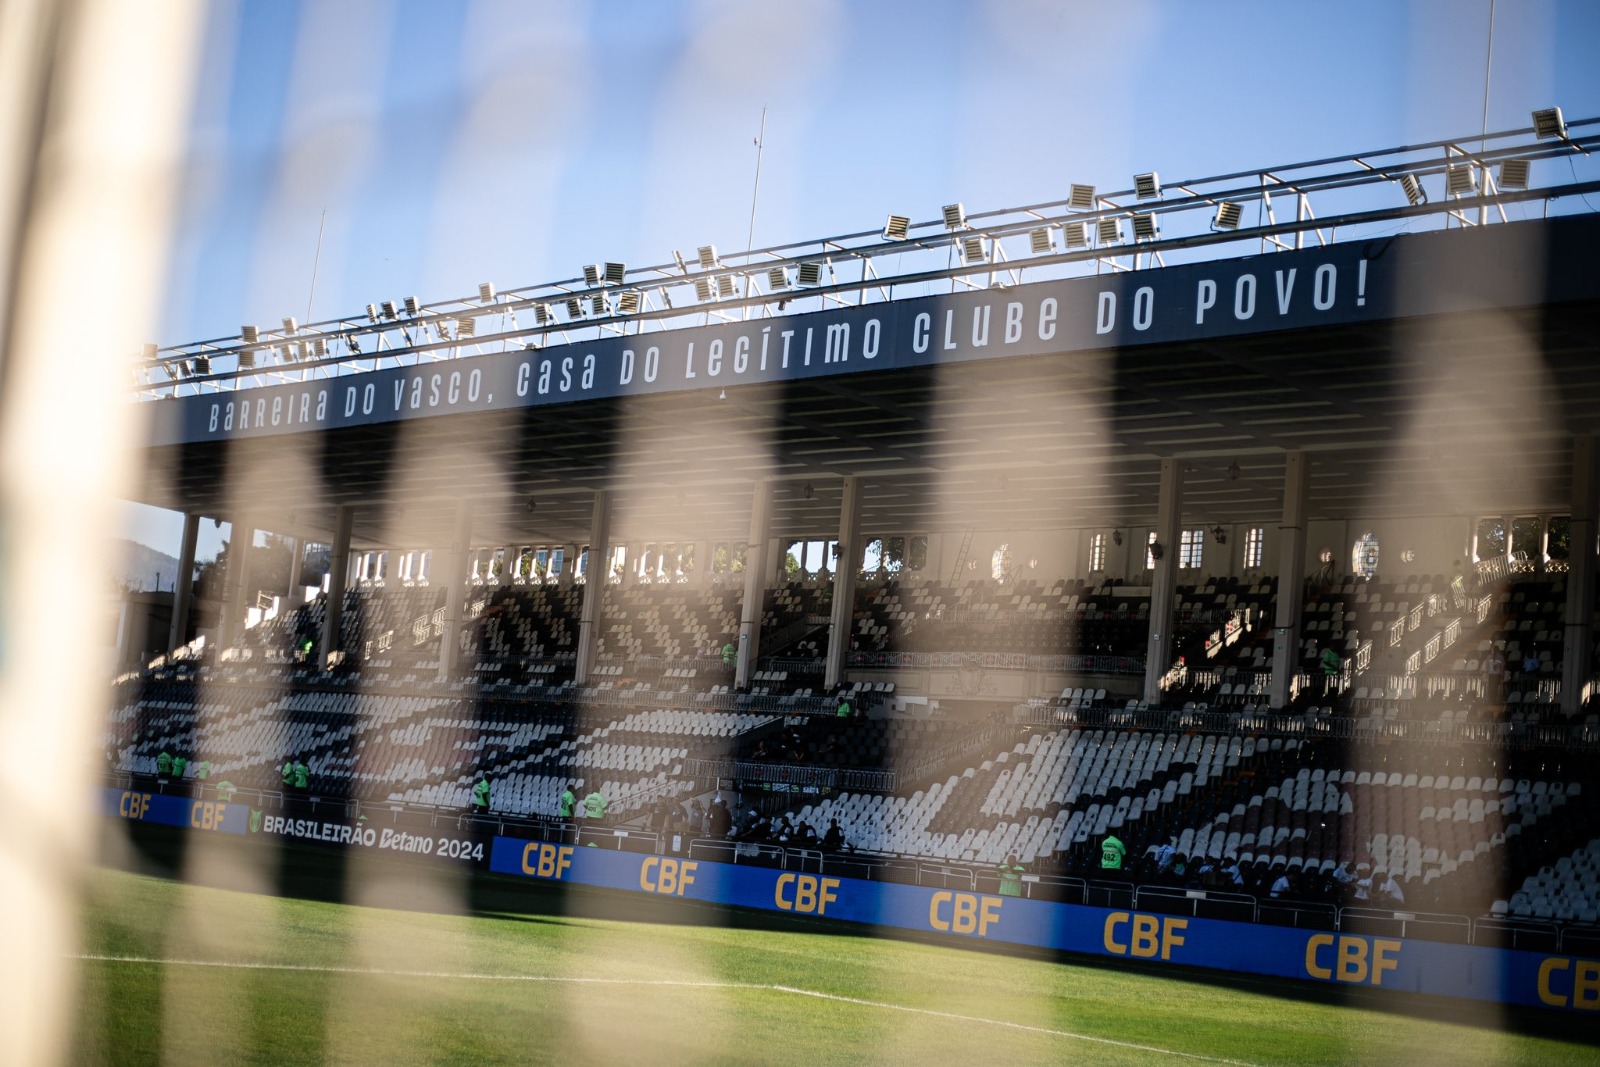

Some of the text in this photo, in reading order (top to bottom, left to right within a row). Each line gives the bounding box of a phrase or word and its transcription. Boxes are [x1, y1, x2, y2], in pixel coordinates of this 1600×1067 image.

[344, 383, 375, 418] DO
[619, 346, 660, 386] DO
[1095, 286, 1155, 335] DO
[1195, 259, 1368, 325] POVO!
[119, 791, 152, 820] CBF
[191, 802, 227, 831] CBF
[263, 815, 484, 862] BRASILEIRÃO Betano 2024
[521, 842, 574, 879] CBF
[640, 856, 698, 898] CBF
[775, 873, 840, 915] CBF
[929, 890, 1004, 938] CBF
[1103, 911, 1188, 960] CBF
[1305, 934, 1402, 985] CBF
